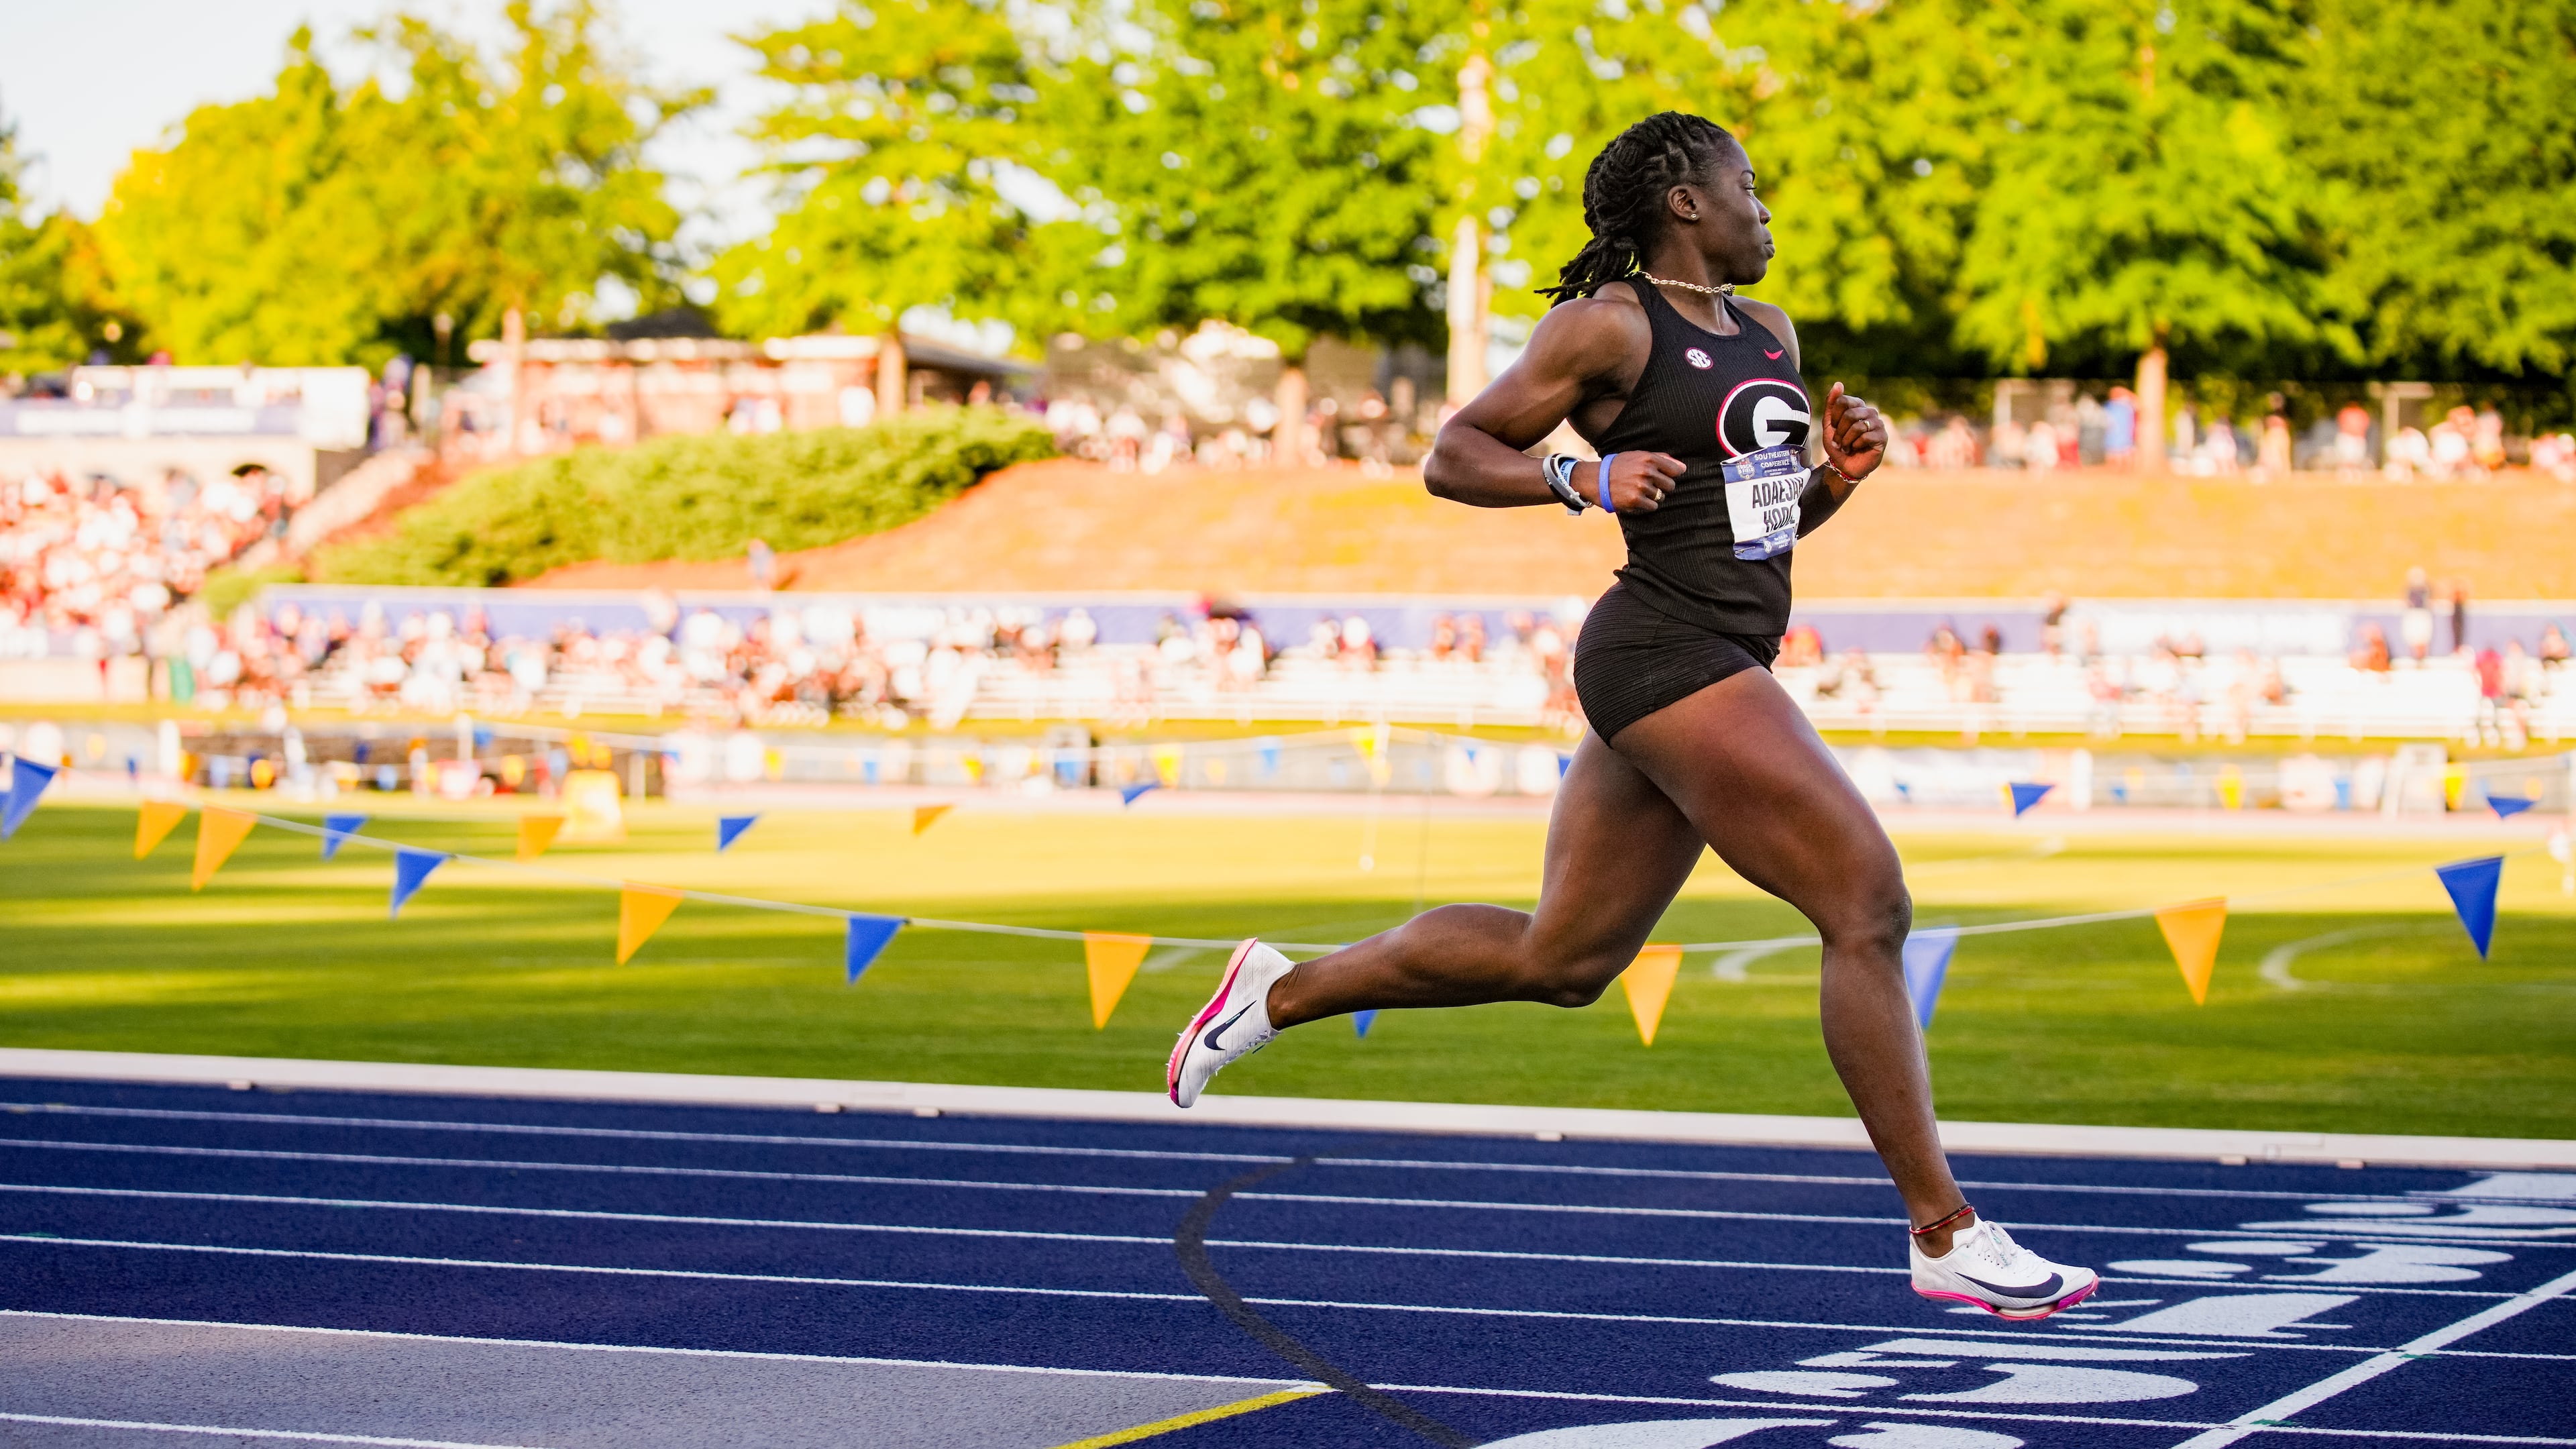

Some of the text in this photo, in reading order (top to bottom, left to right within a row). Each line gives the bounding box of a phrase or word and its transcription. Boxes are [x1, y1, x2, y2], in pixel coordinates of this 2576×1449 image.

[1686, 348, 1712, 368] SEC
[1719, 380, 1811, 457] G
[1754, 449, 1790, 460] SOUTHEASTERN
[1760, 459, 1790, 468] CONFERENCE
[1752, 477, 1804, 509] ADAEJAH
[2106, 1240, 2514, 1283] 3
[1947, 1292, 2361, 1338] 4
[1709, 1338, 2253, 1404] 5
